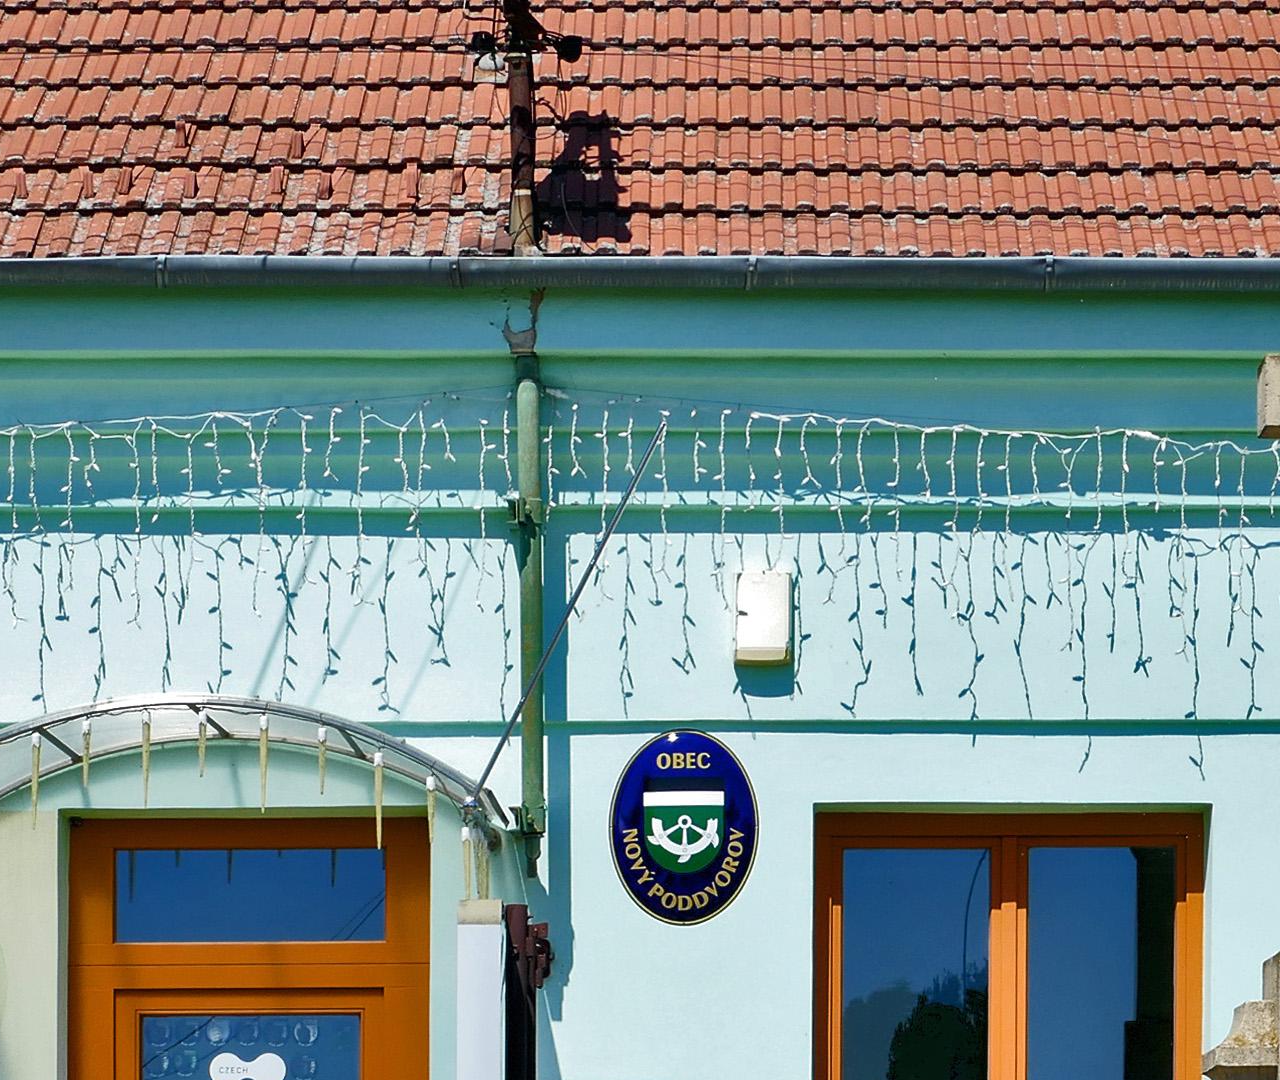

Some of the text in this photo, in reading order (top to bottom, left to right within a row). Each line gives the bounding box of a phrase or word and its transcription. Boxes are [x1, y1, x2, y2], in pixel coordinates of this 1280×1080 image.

[656, 752, 711, 769] OBEC
[622, 827, 745, 911] NOVÝ PODDVOROV
[219, 1066, 248, 1074] CZECH
